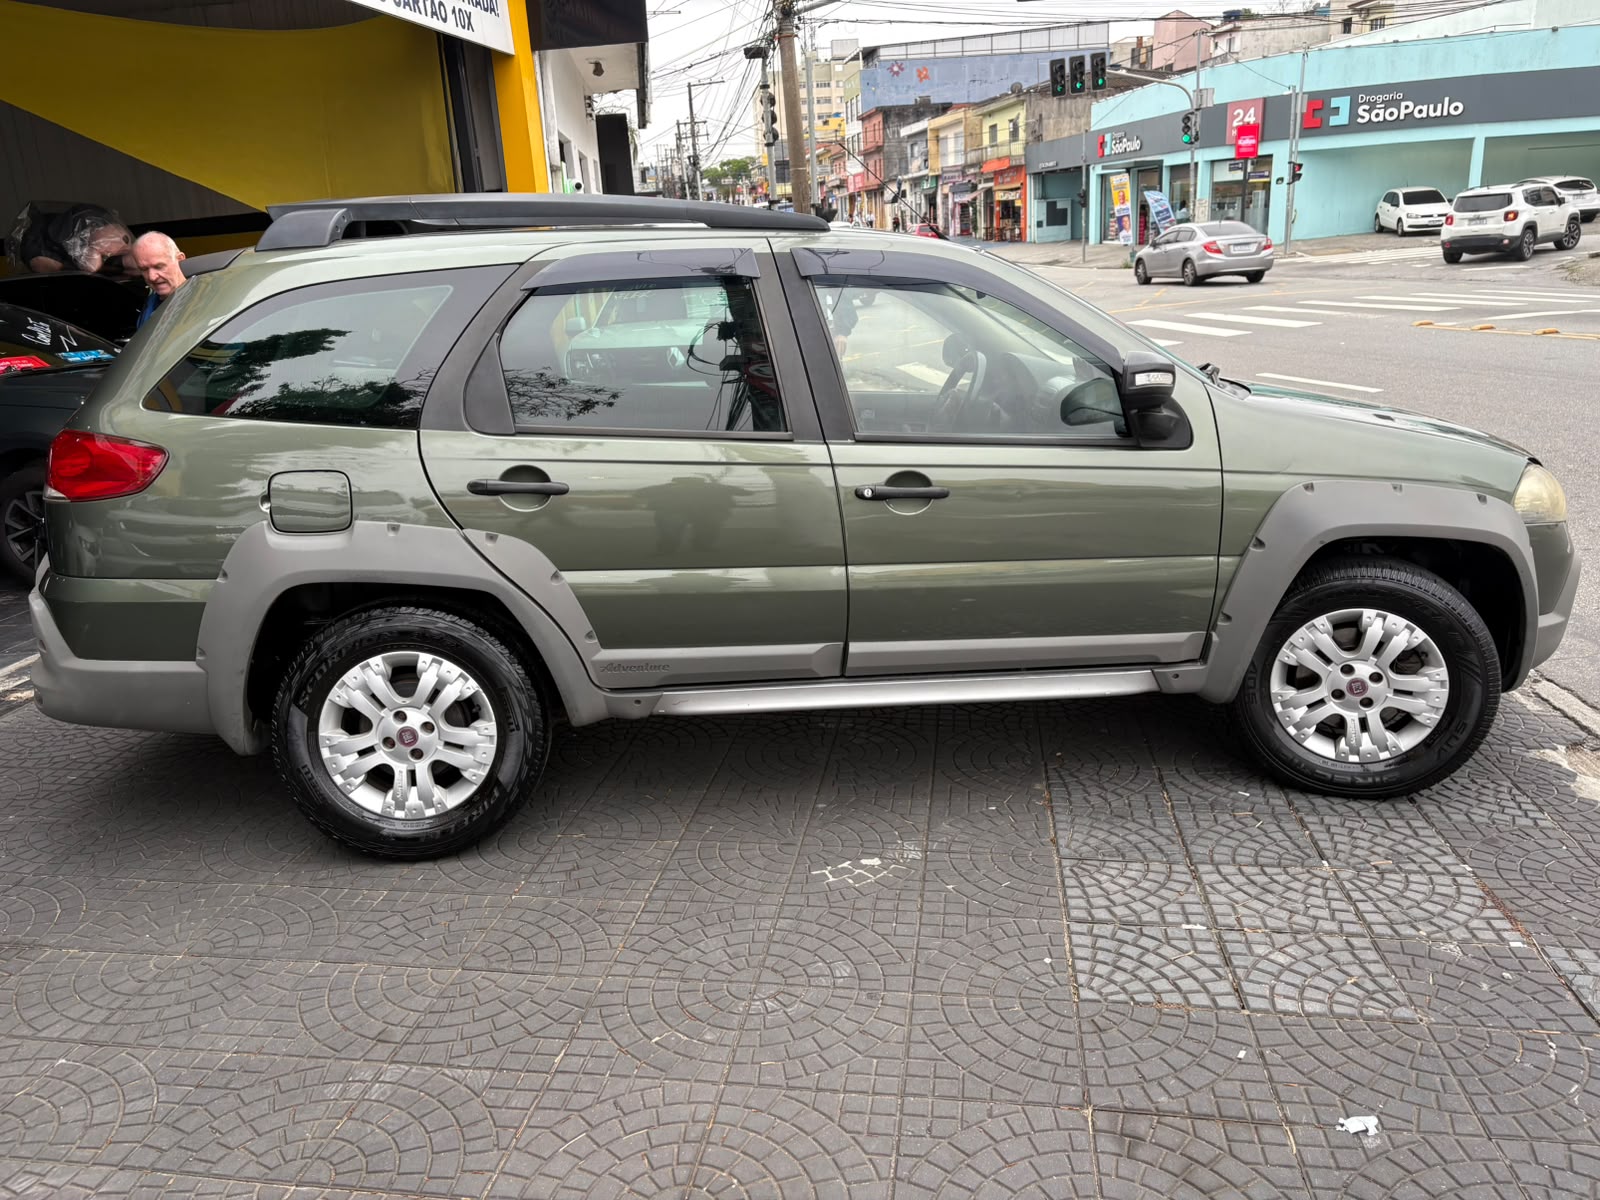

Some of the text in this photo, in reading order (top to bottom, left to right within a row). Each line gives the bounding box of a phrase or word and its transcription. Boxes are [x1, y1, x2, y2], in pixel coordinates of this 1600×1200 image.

[451, 5, 475, 33] 10X
[1358, 91, 1404, 104] Drogaria
[1232, 106, 1256, 127] 24
[1356, 96, 1465, 124] SãoPaulo
[600, 662, 671, 674] Adventure
